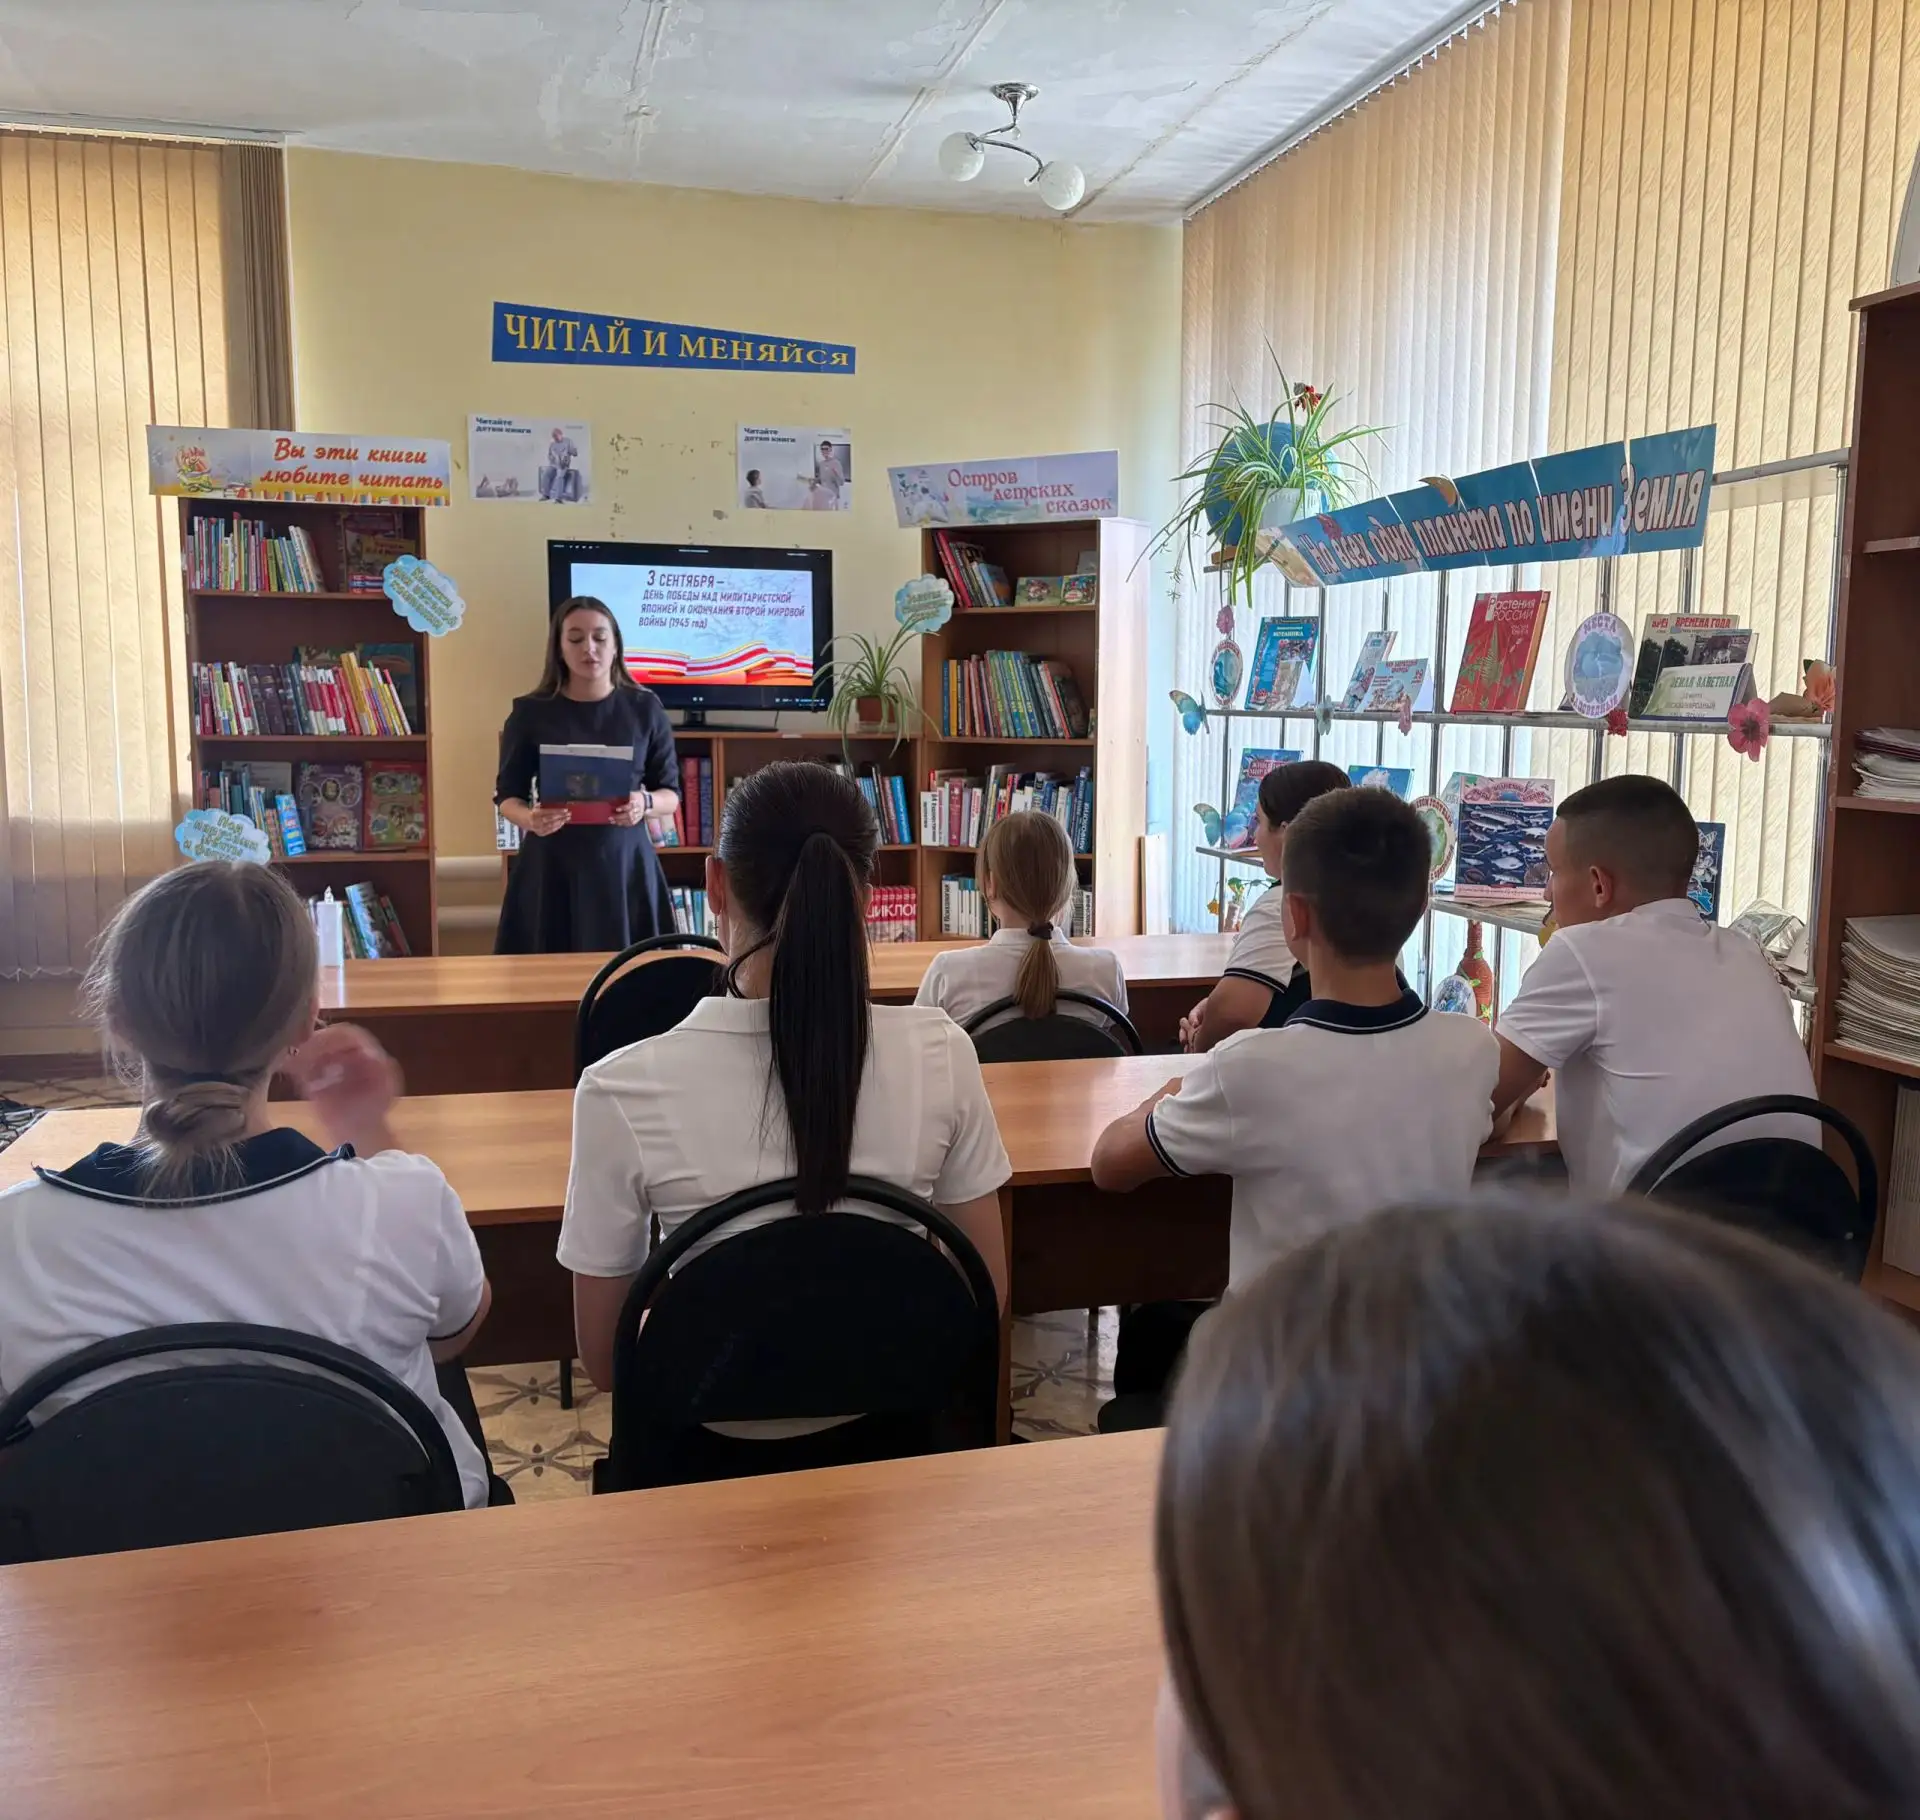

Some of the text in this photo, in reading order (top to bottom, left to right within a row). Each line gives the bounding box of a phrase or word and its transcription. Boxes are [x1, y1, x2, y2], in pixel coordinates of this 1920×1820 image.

[504, 313, 849, 366] ЧИТАЙ И МЕНЯЙСЯ
[475, 416, 513, 426] Читайте
[743, 427, 779, 435] Читайте
[274, 437, 428, 464] Вы эти книги
[259, 464, 444, 489] любите читать
[948, 469, 1018, 491] Остров
[993, 483, 1074, 507] детских
[1046, 497, 1113, 514] сказок
[1299, 463, 1707, 574] На всех одна планета по имени Земля
[647, 570, 656, 586] 3
[659, 573, 715, 588] СЕНТЯБРЯ
[643, 590, 792, 604] ДЕНЬ ПОБЕДЫ НАД МИЛИТАРИСТСКОЙ
[641, 602, 806, 618] ЯПОНИЕЙ И ОКОНЧАНИЯ ВТОРОЙ МИРОВОЙ
[638, 613, 708, 629] ВОЙНЫ (1945 год)
[1583, 615, 1617, 634] МЕСТА
[1675, 617, 1733, 629] ВРЕМЕНА ГОДА
